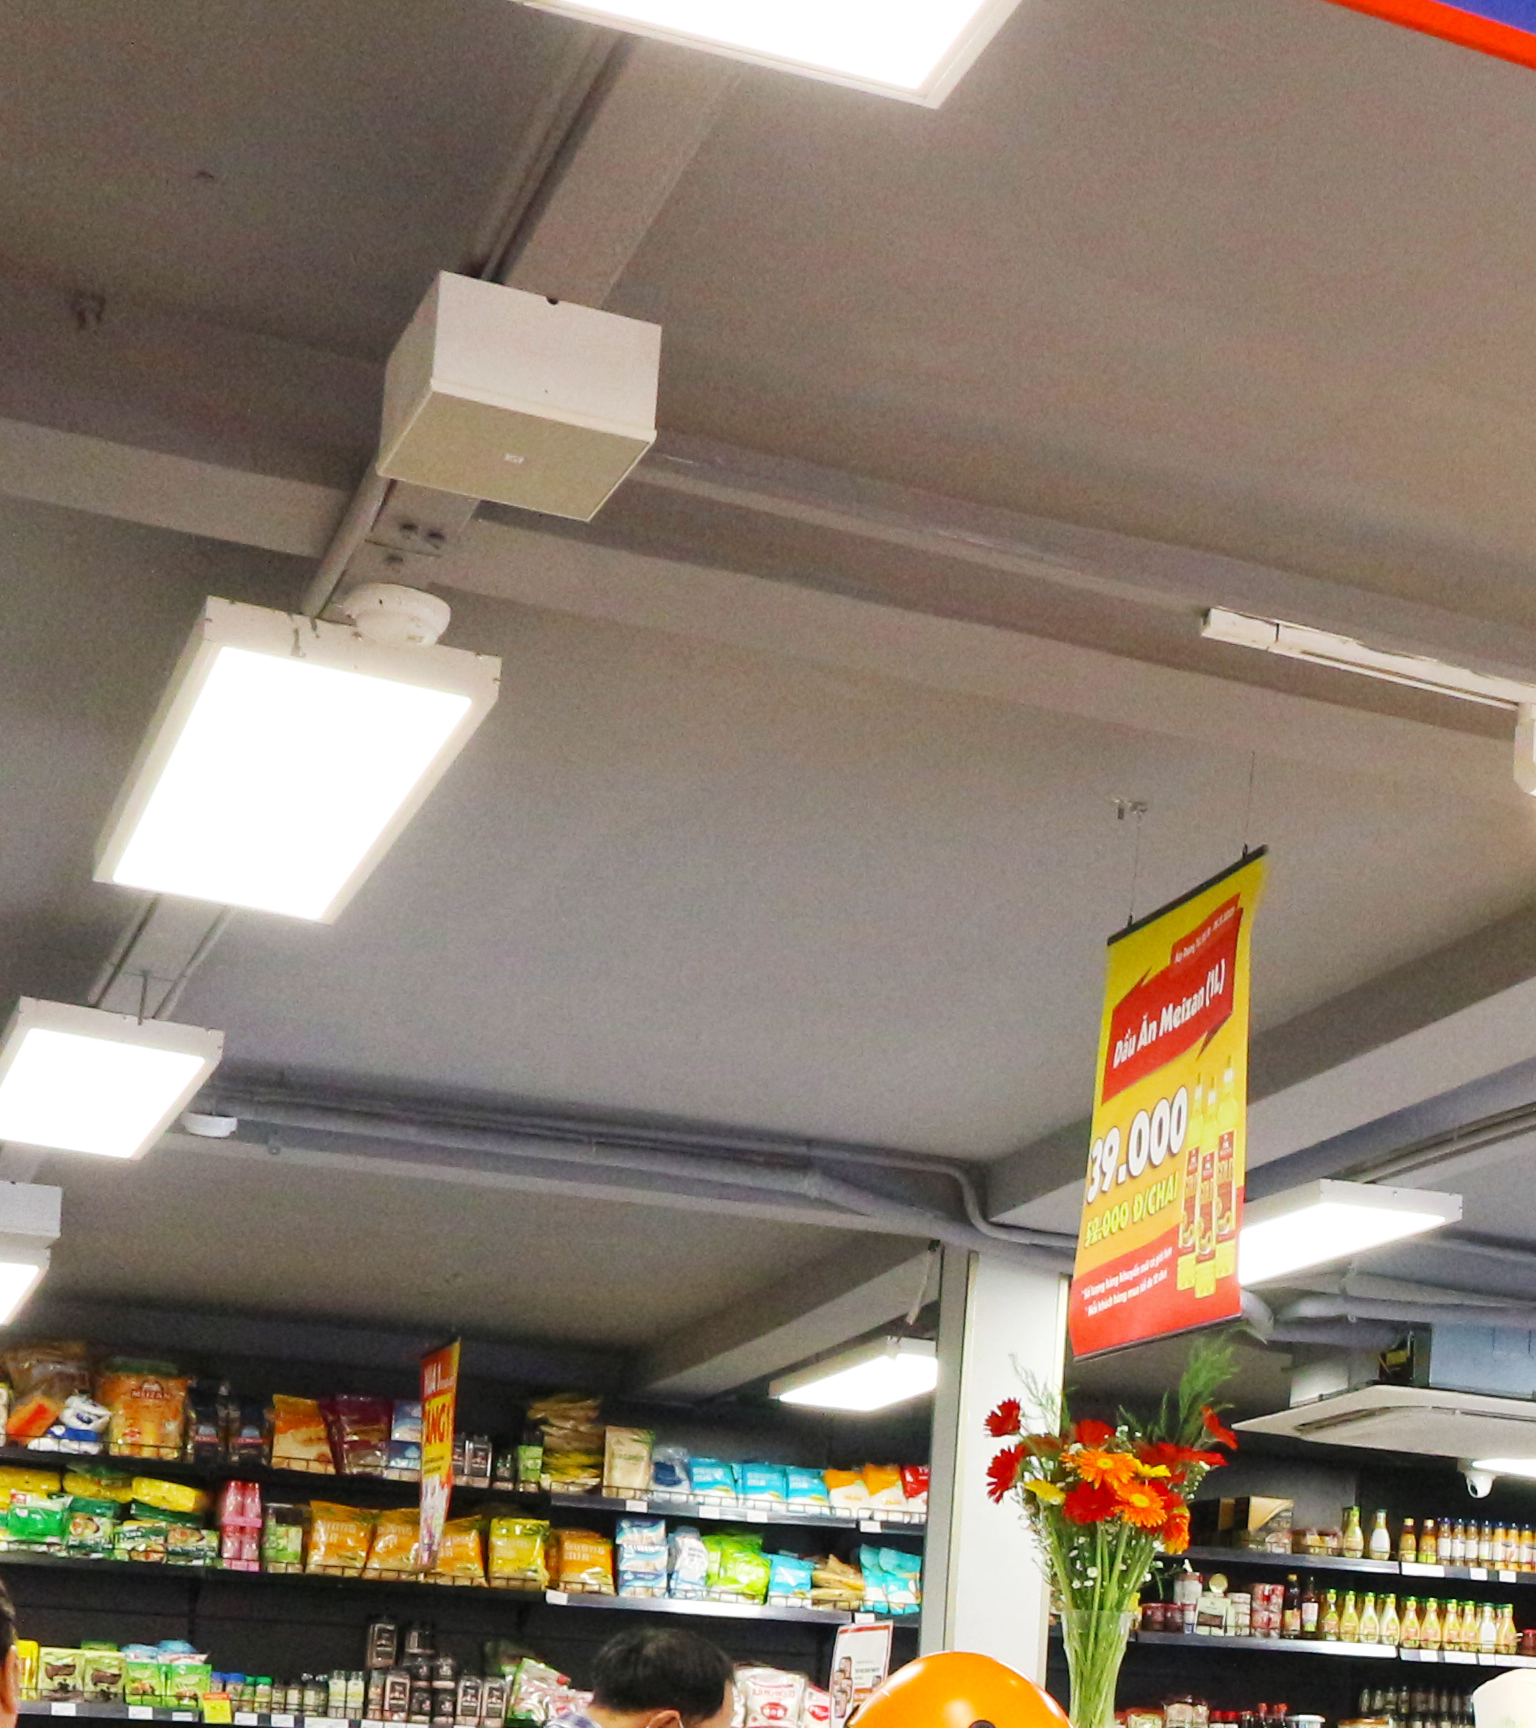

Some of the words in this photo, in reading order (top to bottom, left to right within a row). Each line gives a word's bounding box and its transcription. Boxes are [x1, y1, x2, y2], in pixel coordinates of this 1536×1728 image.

[1159, 986, 1205, 1037] Meizan
[1087, 1085, 1188, 1204] 39.000
[1132, 1171, 1179, 1223] Đ/CHAI
